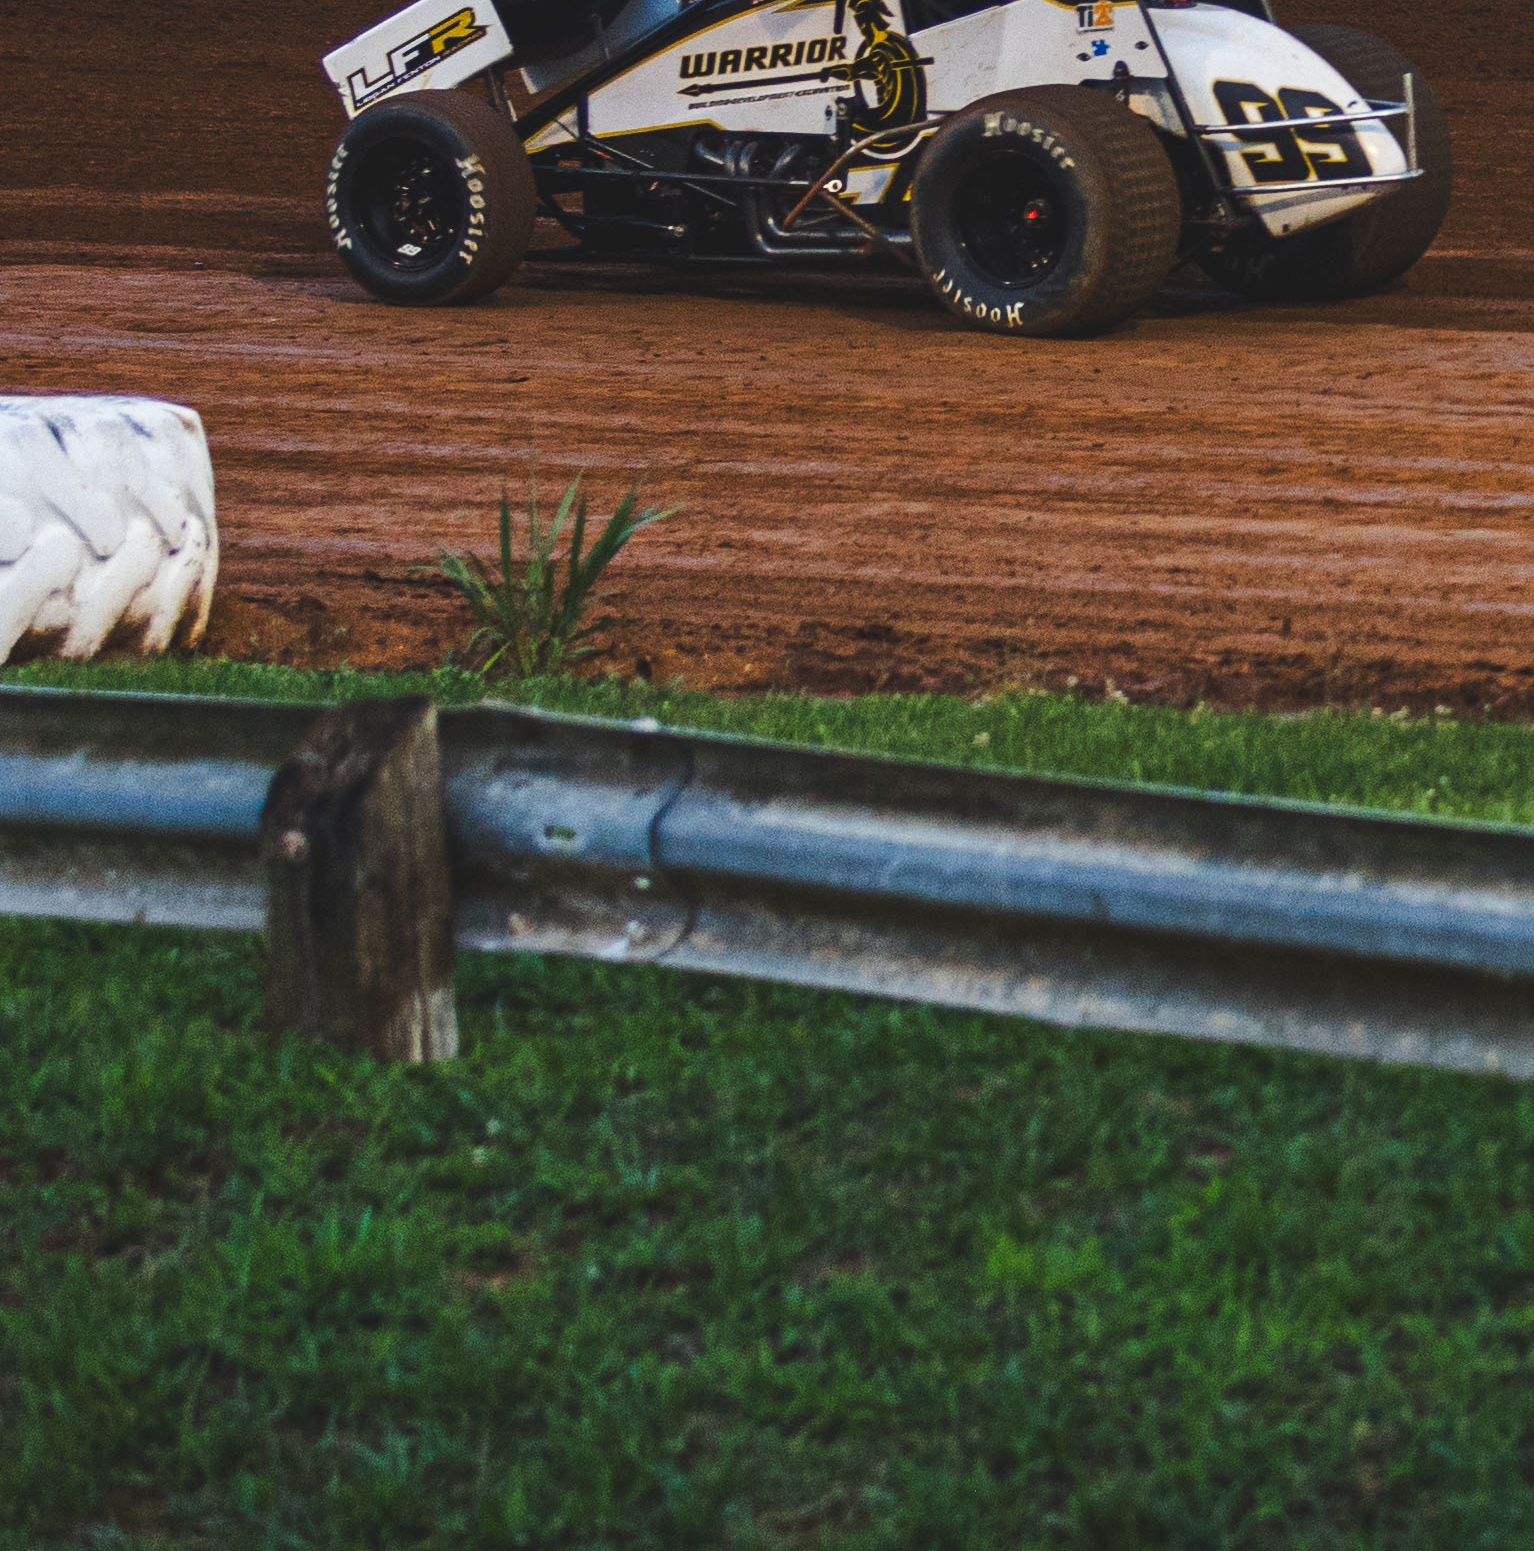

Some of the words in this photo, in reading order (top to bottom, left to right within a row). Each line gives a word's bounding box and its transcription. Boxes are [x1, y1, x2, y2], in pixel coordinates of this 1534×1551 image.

[347, 7, 485, 103] LFR
[680, 35, 847, 80] WARRIOR
[1212, 79, 1374, 185] 99
